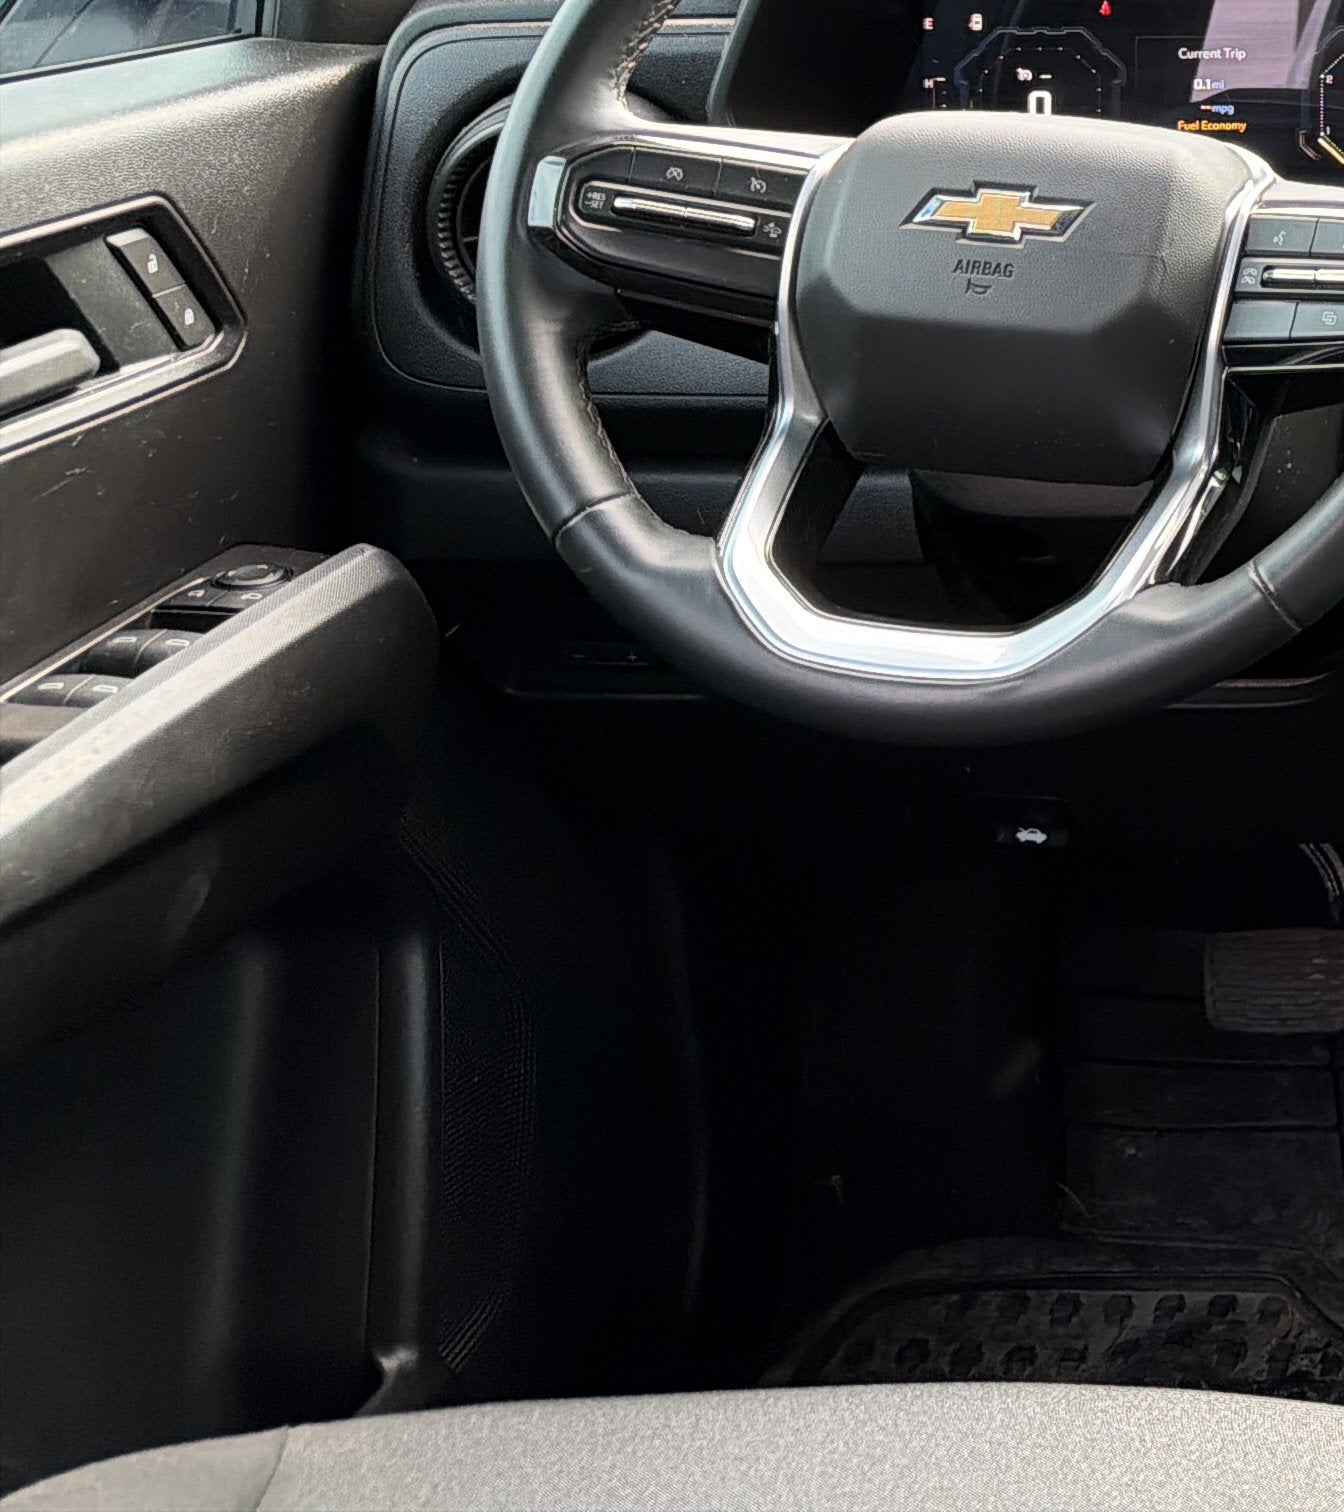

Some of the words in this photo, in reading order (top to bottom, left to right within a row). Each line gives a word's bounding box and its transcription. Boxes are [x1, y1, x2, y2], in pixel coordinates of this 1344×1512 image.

[1178, 47, 1222, 60] Current
[1223, 47, 1247, 61] Trip
[1193, 78, 1211, 90] 0.1
[1212, 79, 1225, 89] mi
[1212, 104, 1235, 115] mpg
[1177, 119, 1200, 131] Fuel
[1201, 119, 1247, 133] Economy
[952, 258, 1015, 278] AIRBAG
